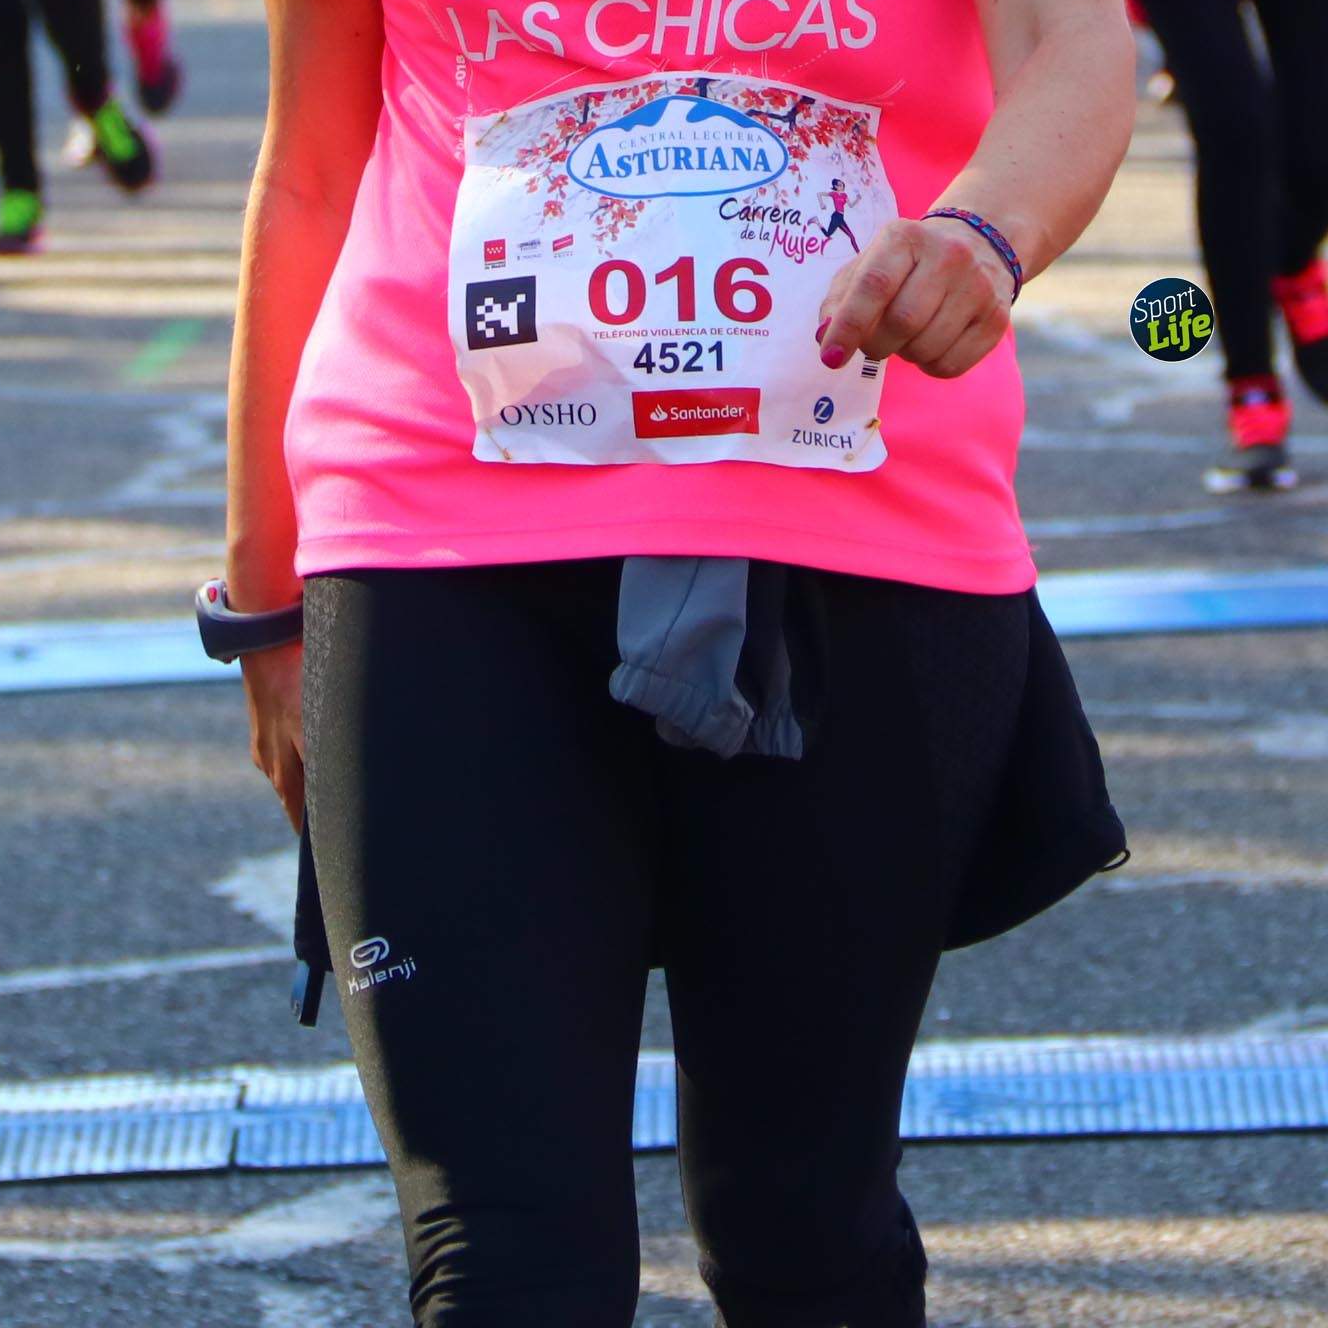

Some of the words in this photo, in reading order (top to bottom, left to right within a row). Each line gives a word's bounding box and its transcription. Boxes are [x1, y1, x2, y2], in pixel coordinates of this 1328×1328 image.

[447, 1, 565, 62] LAS
[619, 130, 685, 150] CENTRAL
[693, 130, 764, 144] LECHERA
[583, 142, 772, 179] ASTURIANA
[719, 197, 801, 226] Carrera
[740, 223, 755, 240] de
[759, 223, 770, 241] la
[769, 224, 832, 264] Mujer
[588, 256, 773, 326] 016
[593, 328, 648, 340] TELÉFONO
[650, 328, 707, 338] VIOLENCIA
[710, 327, 724, 336] DE
[726, 327, 769, 337] GÉNERO
[633, 341, 723, 374] 4521
[500, 402, 597, 427] OYSHO
[670, 404, 745, 421] Santander
[791, 429, 853, 449] ZURICH
